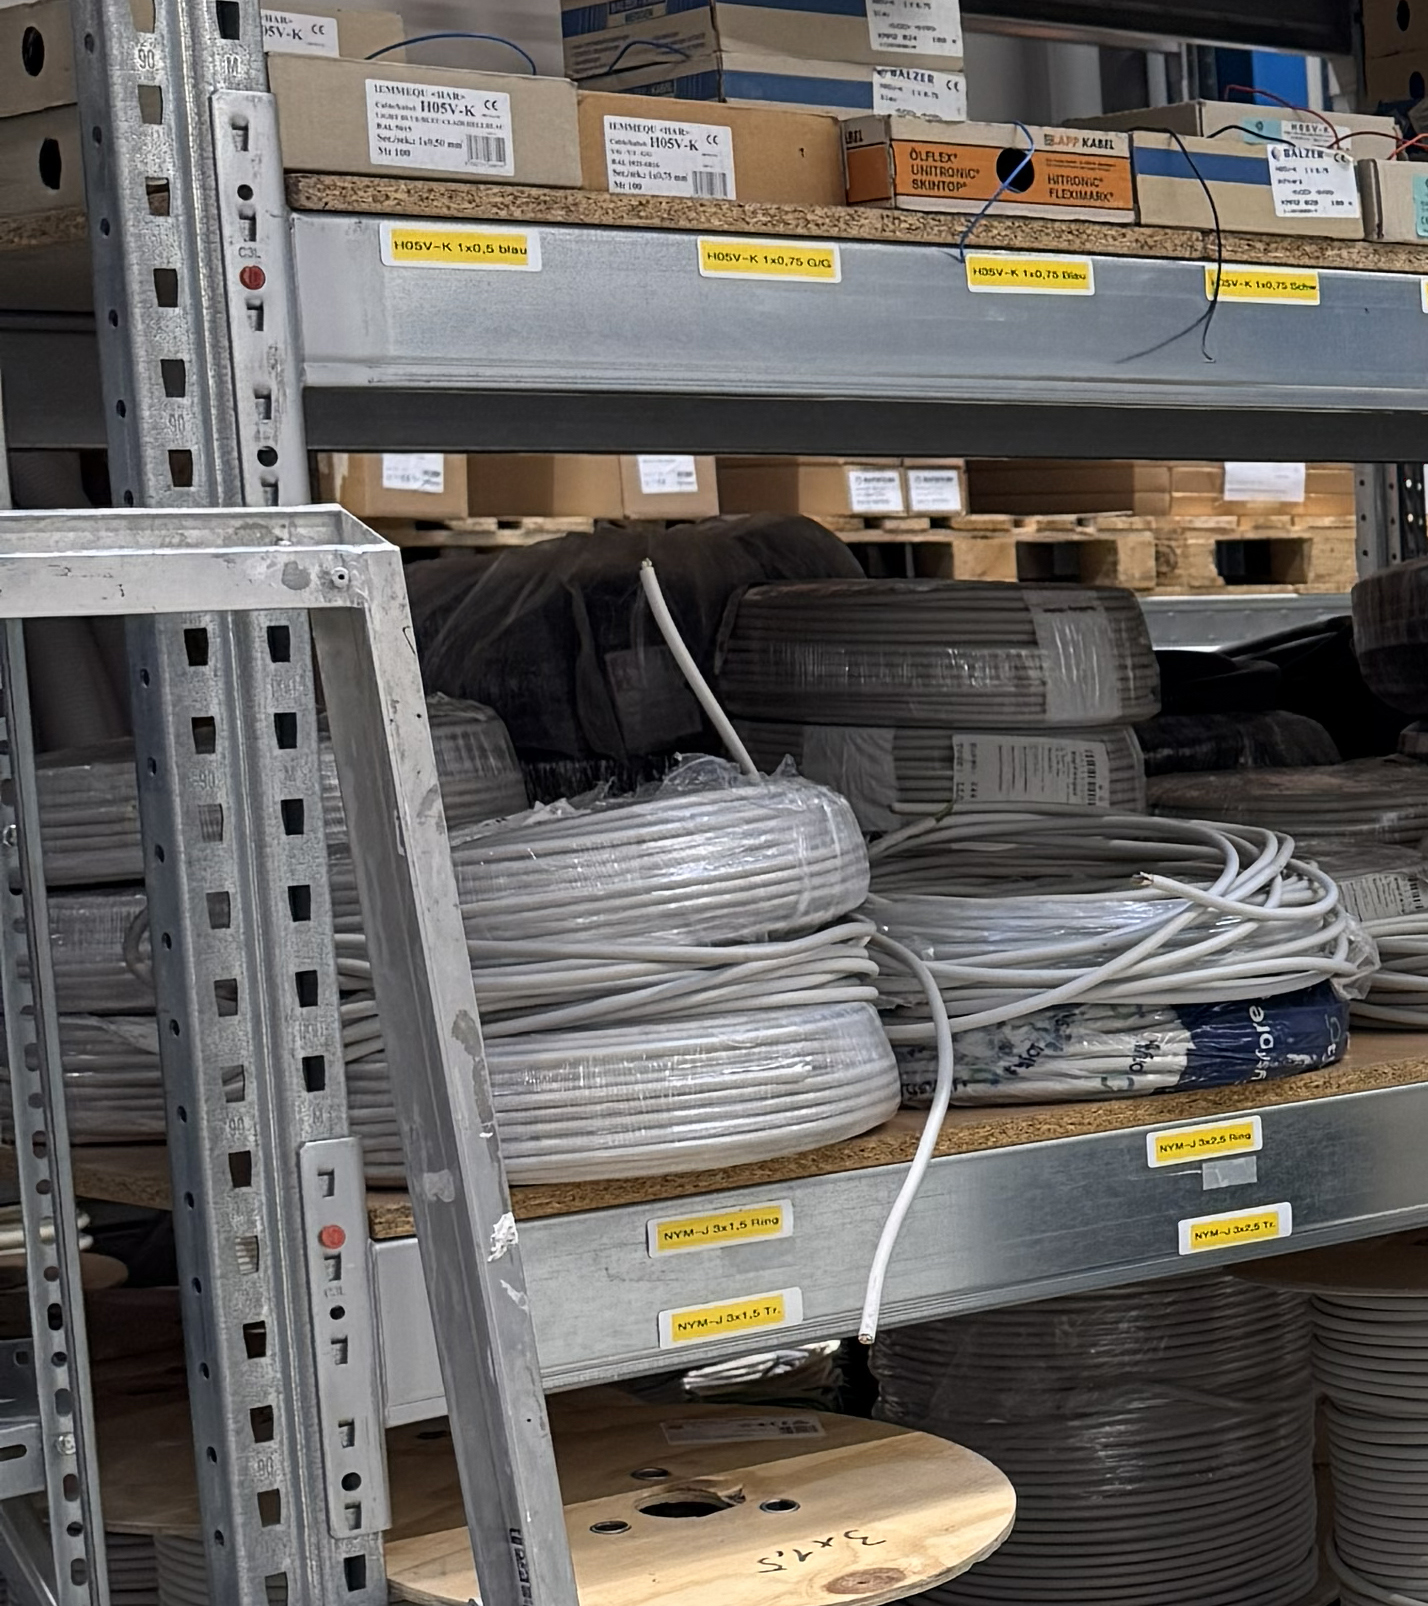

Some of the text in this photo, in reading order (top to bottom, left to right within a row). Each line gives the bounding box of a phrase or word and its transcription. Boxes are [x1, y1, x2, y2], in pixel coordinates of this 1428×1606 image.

[263, 25, 303, 41] 05V-K
[138, 49, 156, 70] 90
[420, 100, 477, 118] H05V-K
[650, 136, 699, 152] H05V-K
[1082, 137, 1116, 150] KABEL
[395, 147, 411, 158] 100
[1283, 148, 1325, 159] BALZER
[394, 240, 528, 255] H05V-K 1x0,5 blau
[707, 251, 759, 264] H05V-K
[763, 255, 804, 267] 1x0,75
[972, 266, 1020, 279] H05V-K
[1023, 268, 1060, 281] 1x0,75
[1211, 277, 1253, 290] H05V-K
[1255, 279, 1288, 292] 1x0,75
[1160, 1132, 1252, 1153] NYM-J 3x2,5 Ring
[664, 1216, 780, 1241] NYM-J 3x1,5 Ring
[1195, 1227, 1231, 1241] NYM-J
[1233, 1222, 1260, 1235] 3x2,5
[678, 1306, 782, 1332] NYM-J 3x1,5 Tr.
